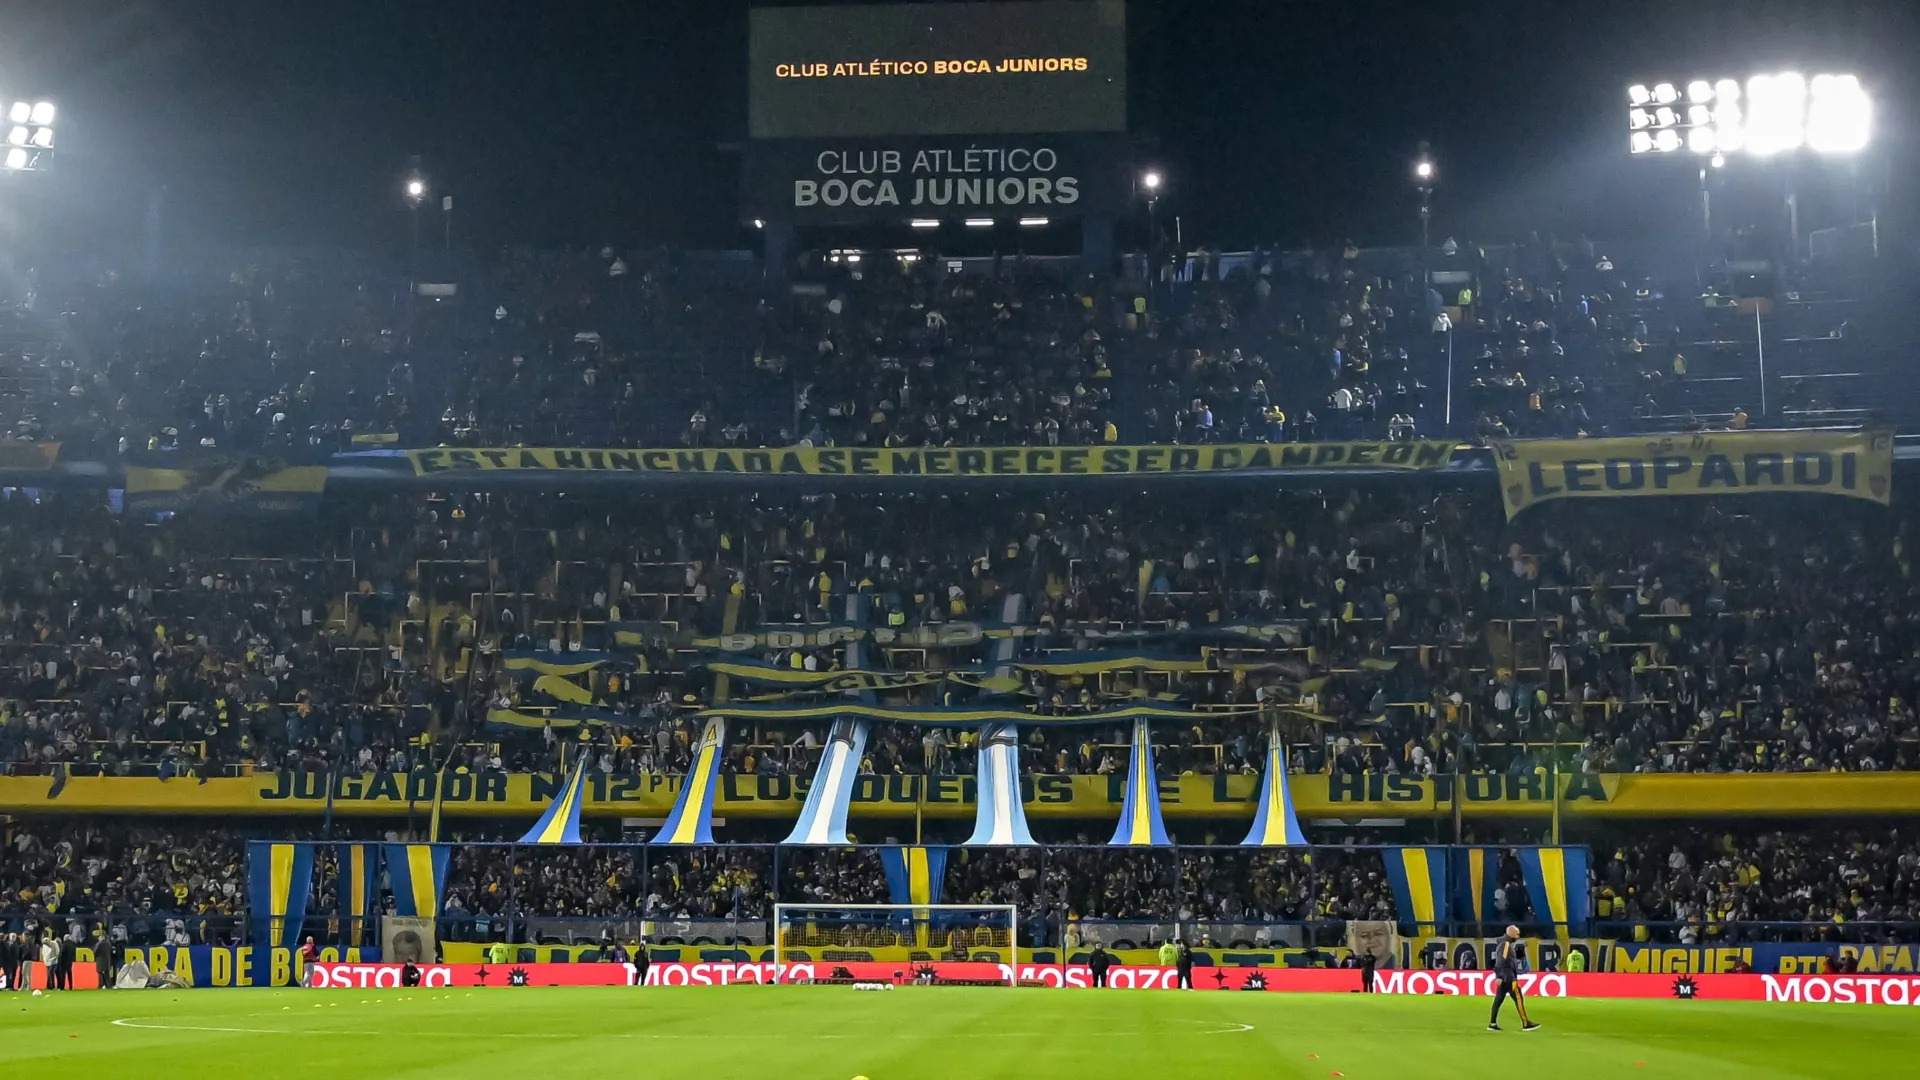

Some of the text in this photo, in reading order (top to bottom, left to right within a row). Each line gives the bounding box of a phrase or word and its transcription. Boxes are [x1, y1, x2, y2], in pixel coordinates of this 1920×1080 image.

[776, 57, 1088, 77] CLUB ATLÉTICO BOCA JUNIORS
[817, 144, 1057, 175] CLUB ATLÉTICO
[795, 176, 1079, 206] BOCA JUNIORS
[416, 450, 544, 473] ESTA
[552, 450, 808, 474] HINCHADA
[818, 450, 880, 475] SE
[892, 450, 1089, 475] MERECE
[1102, 448, 1199, 474] SER
[1528, 452, 1857, 496] LEOPARDI
[259, 770, 507, 802] JUGADOR
[588, 772, 642, 802] 12
[650, 775, 685, 794] PT
[1329, 772, 1610, 803] HISTORIA
[212, 946, 252, 986] DE
